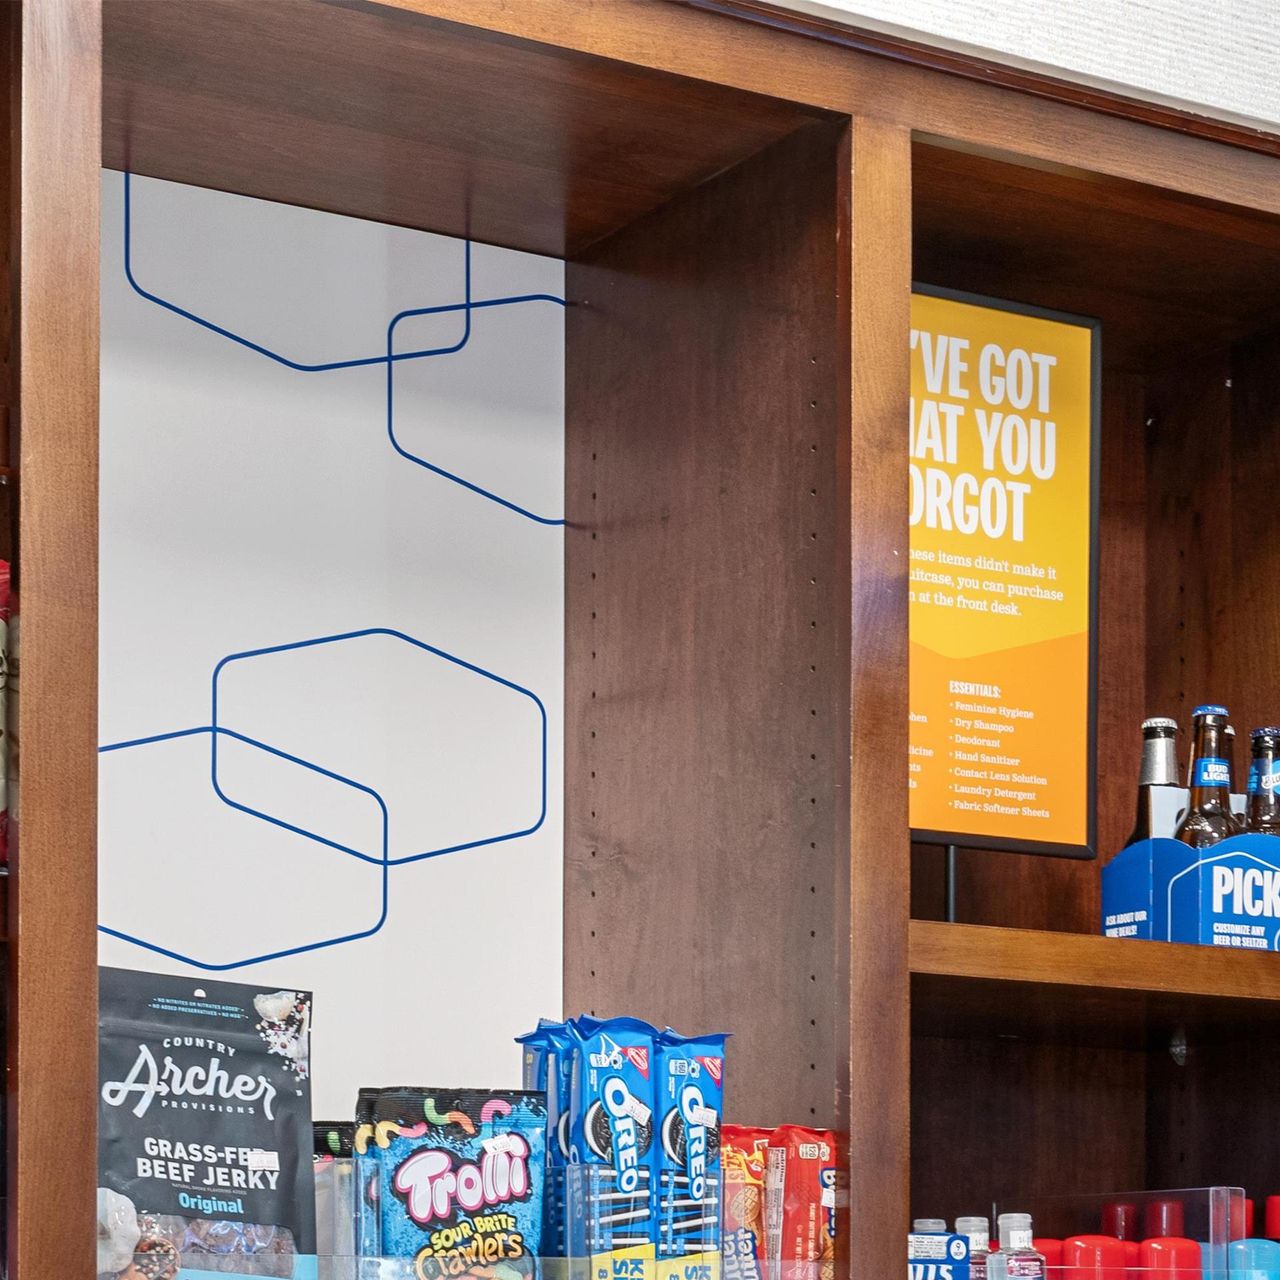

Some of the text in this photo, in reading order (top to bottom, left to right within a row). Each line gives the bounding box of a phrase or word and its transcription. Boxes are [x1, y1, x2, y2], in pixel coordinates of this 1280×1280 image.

[979, 343, 1057, 414] GOT
[974, 408, 1056, 481] YOU
[938, 550, 1045, 578] items didn't make
[957, 578, 1064, 601] you can purchase
[957, 595, 1022, 616] front desk.
[949, 680, 1001, 698] ESSENTIALS:
[955, 702, 1034, 720] Feminine Hygiene
[955, 718, 1014, 733] Dry Shampoo
[955, 734, 1001, 748] Deodorant
[954, 751, 1020, 767] Hand Sanitizer
[954, 799, 1050, 819] Fabric Softener Sheets
[163, 1038, 236, 1057] COUNTRY
[102, 1044, 276, 1120] Archer
[162, 1100, 255, 1114] PROVISIONS
[601, 1076, 639, 1193] OREO
[137, 1158, 280, 1191] BEEF JERKY
[396, 1134, 528, 1222] Trolli
[179, 1193, 244, 1214] Original
[431, 1223, 472, 1250] SOUR
